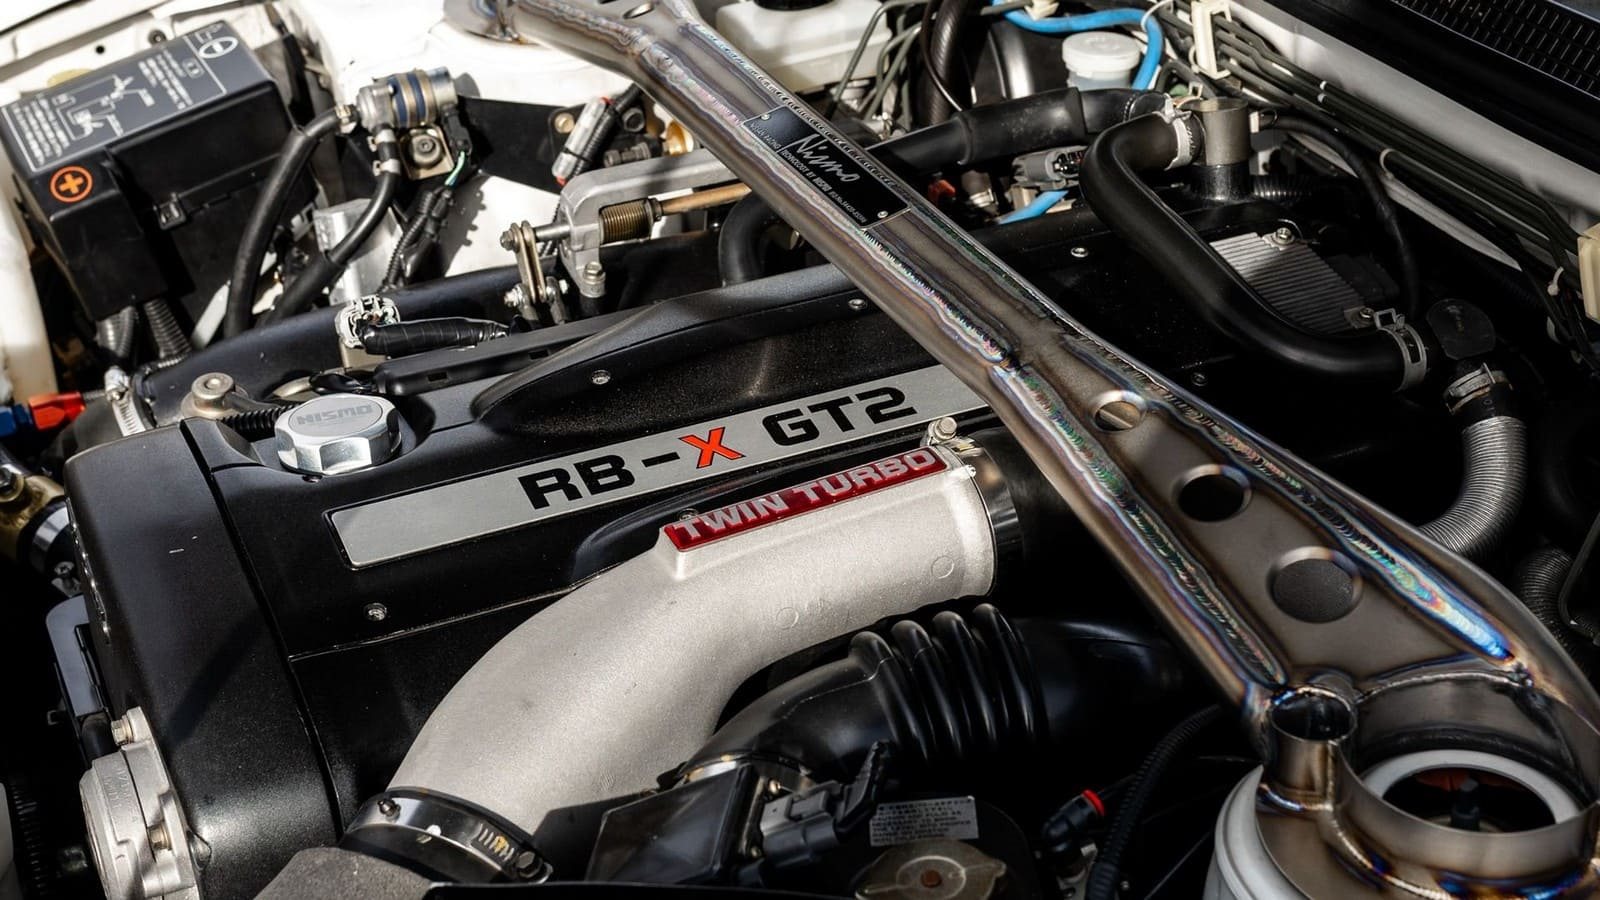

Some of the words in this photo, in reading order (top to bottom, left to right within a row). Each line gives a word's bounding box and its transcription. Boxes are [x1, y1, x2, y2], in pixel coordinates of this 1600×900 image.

[777, 133, 861, 183] Nismo
[296, 404, 373, 425] NISMO
[518, 427, 746, 510] RB-X
[762, 387, 917, 446] GT2
[673, 493, 789, 540] TWIN
[794, 450, 936, 503] TURBO
